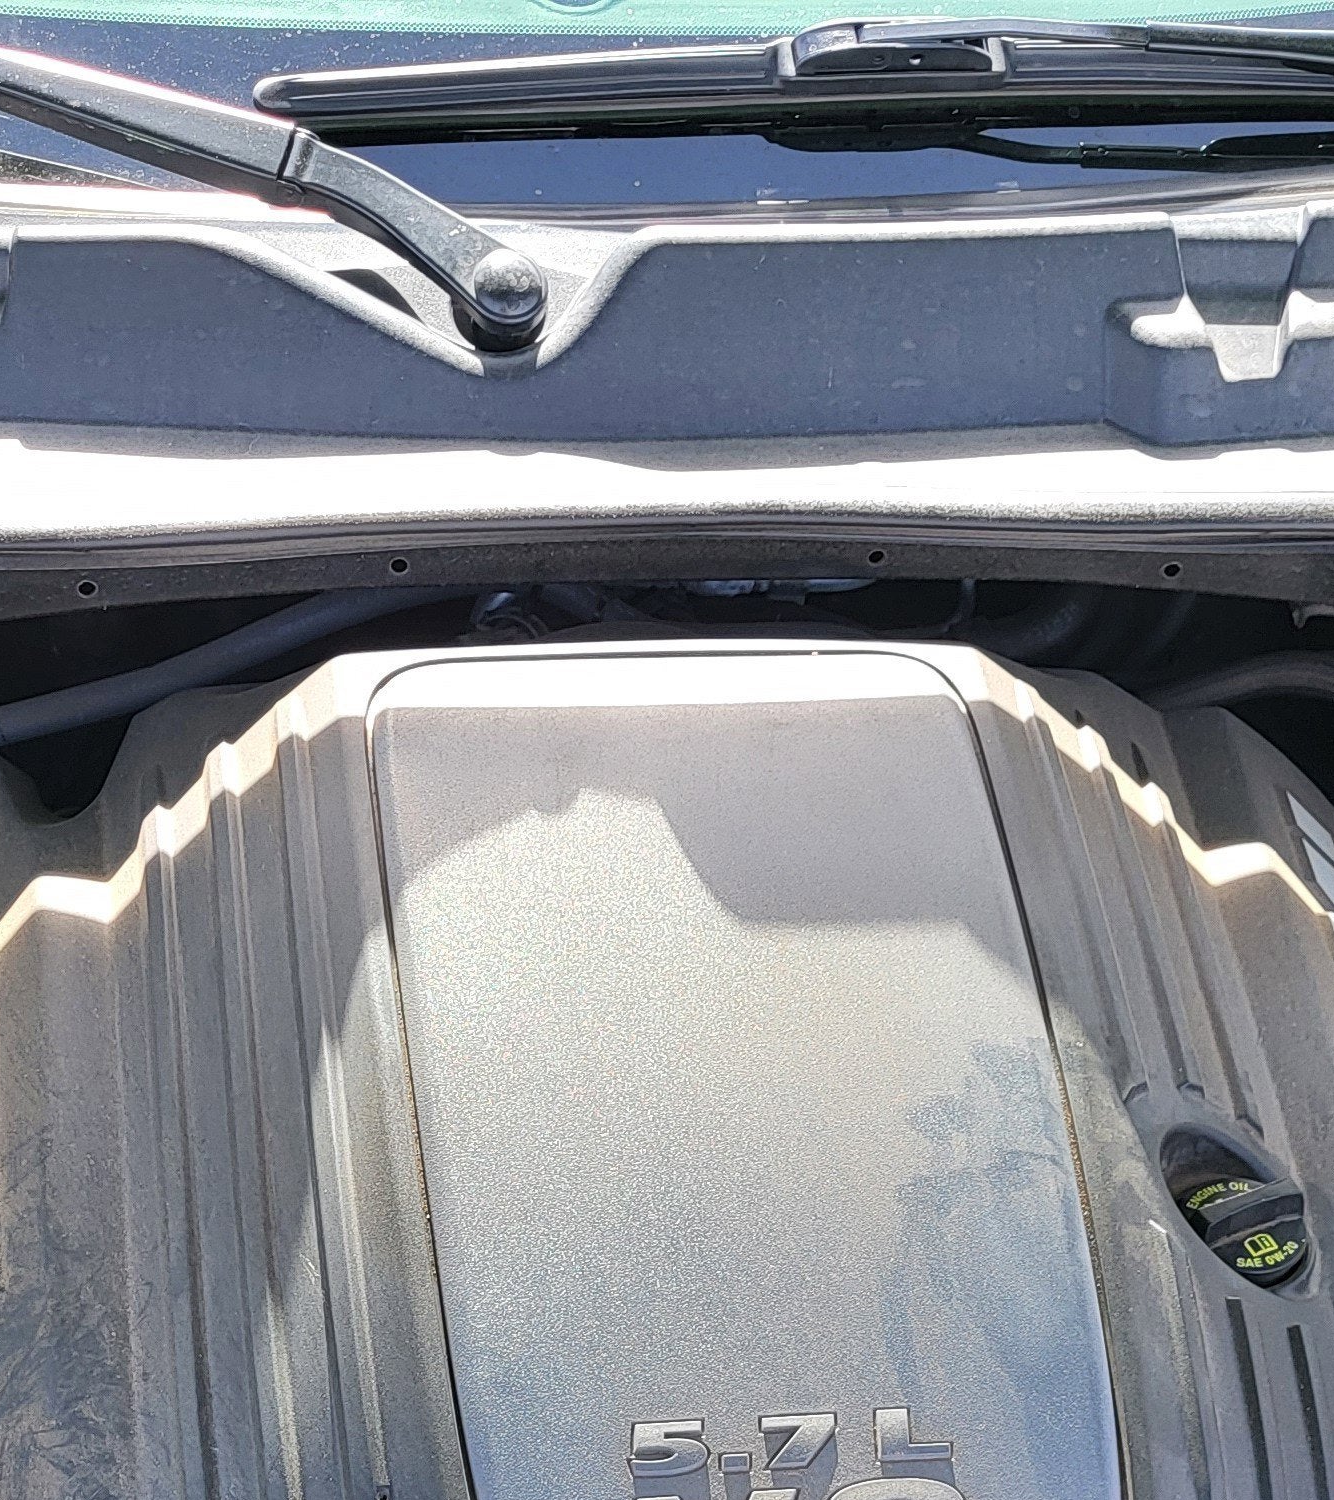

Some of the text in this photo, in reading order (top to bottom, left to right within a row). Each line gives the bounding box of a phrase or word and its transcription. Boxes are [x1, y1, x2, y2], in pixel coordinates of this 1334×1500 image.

[1186, 1182, 1228, 1210] ENGINE
[1228, 1181, 1251, 1193] OIL
[1236, 1240, 1299, 1268] SAE 0W-20
